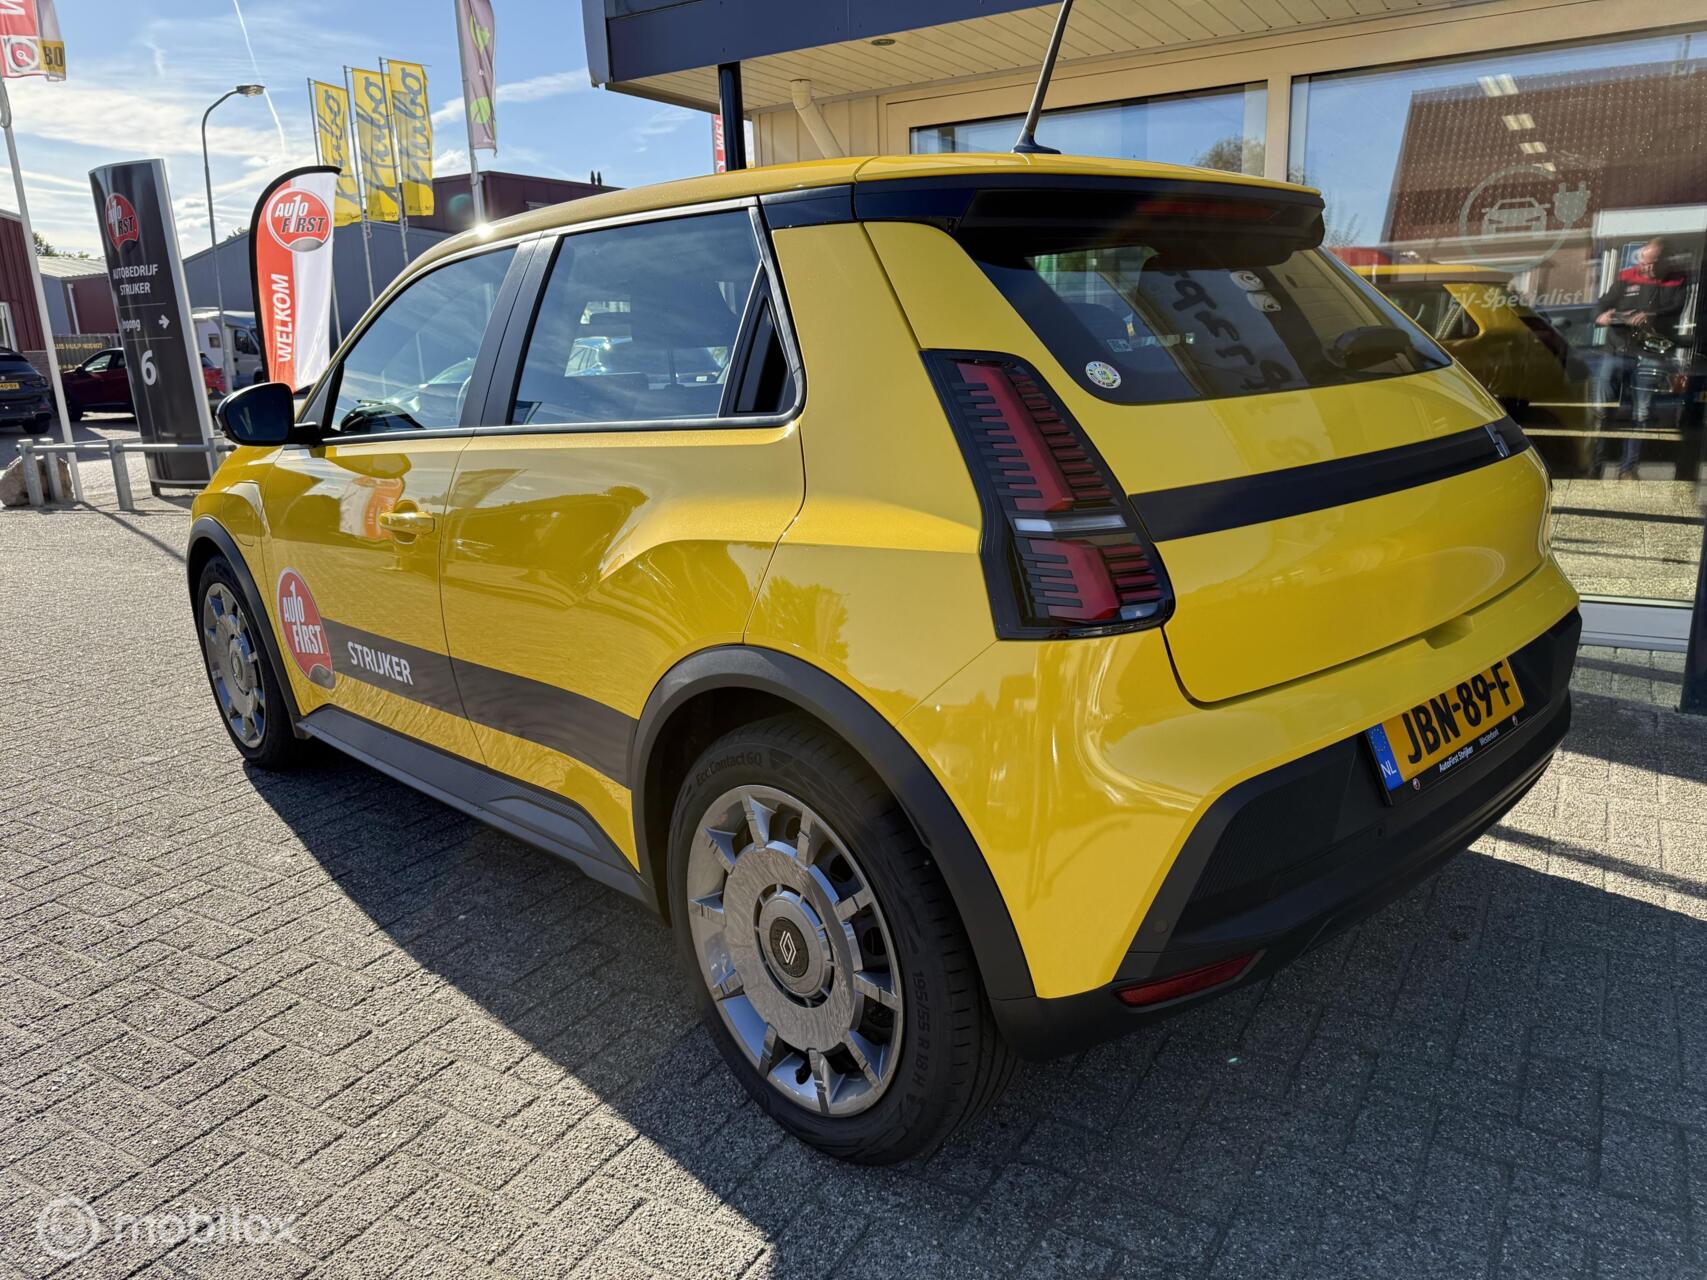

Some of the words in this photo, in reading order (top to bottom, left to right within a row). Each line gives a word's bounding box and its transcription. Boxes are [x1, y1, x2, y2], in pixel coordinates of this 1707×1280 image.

[355, 76, 400, 205] Hubo
[393, 67, 433, 190] Hubo
[113, 264, 158, 280] AUTOBEDRIJF
[120, 282, 151, 296] STRIJKER
[271, 273, 292, 363] WELKOM
[141, 349, 157, 386] 6
[292, 624, 324, 655] FIRST
[347, 641, 414, 686] STRIJKER
[1402, 660, 1511, 764] JBN-89-F
[1380, 760, 1397, 779] NL
[913, 969, 931, 1033] 195/55
